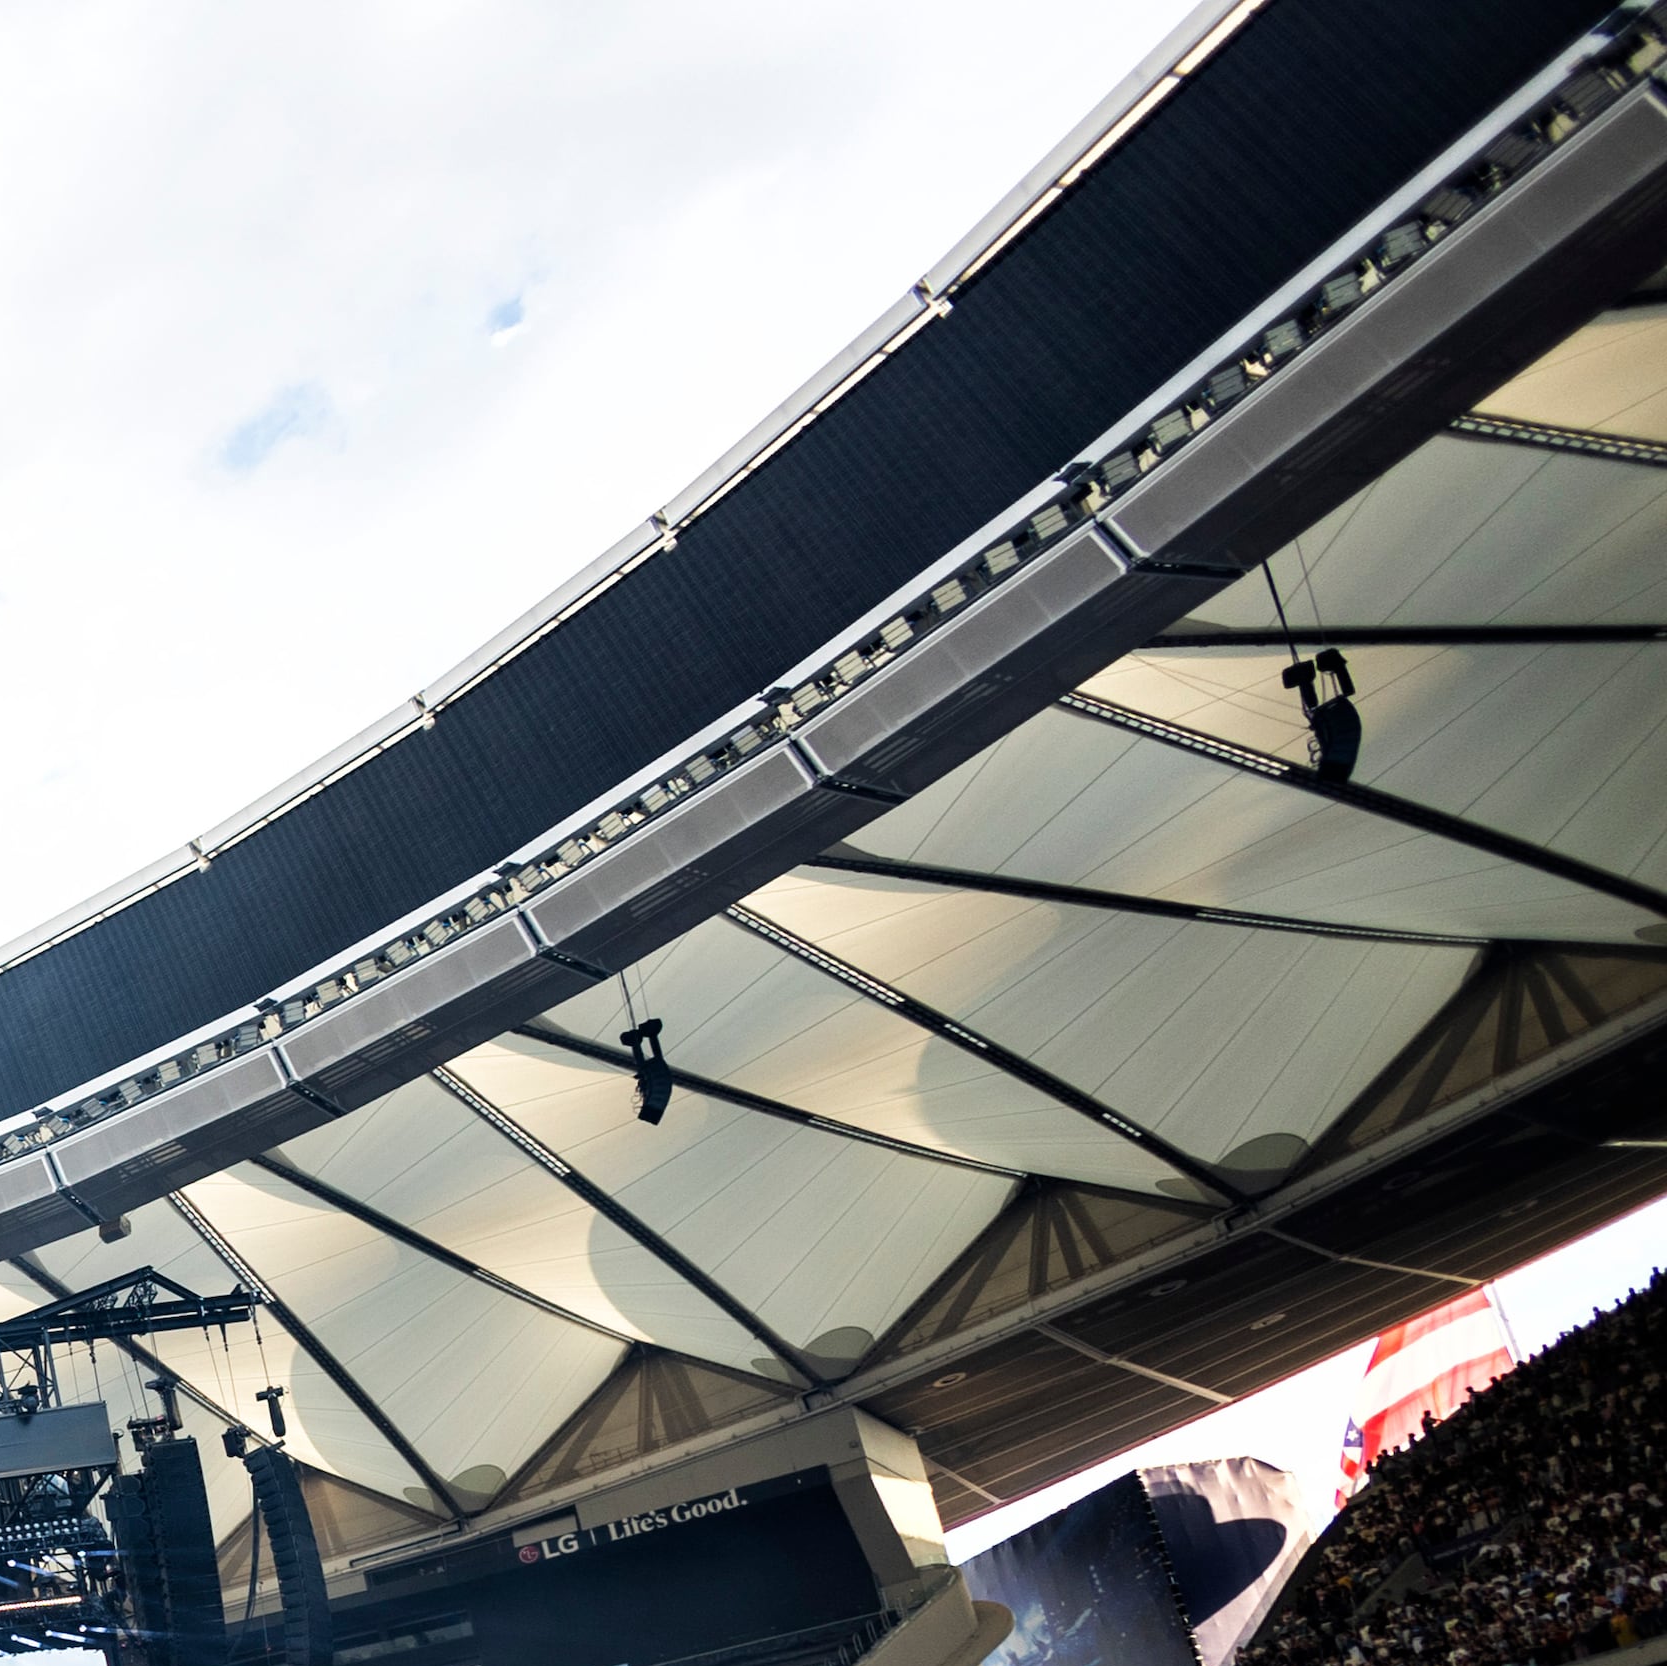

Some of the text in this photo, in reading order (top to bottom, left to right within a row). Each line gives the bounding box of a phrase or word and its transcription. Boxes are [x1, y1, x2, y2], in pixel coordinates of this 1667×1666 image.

[540, 1487, 748, 1560] LG Life's Good.
